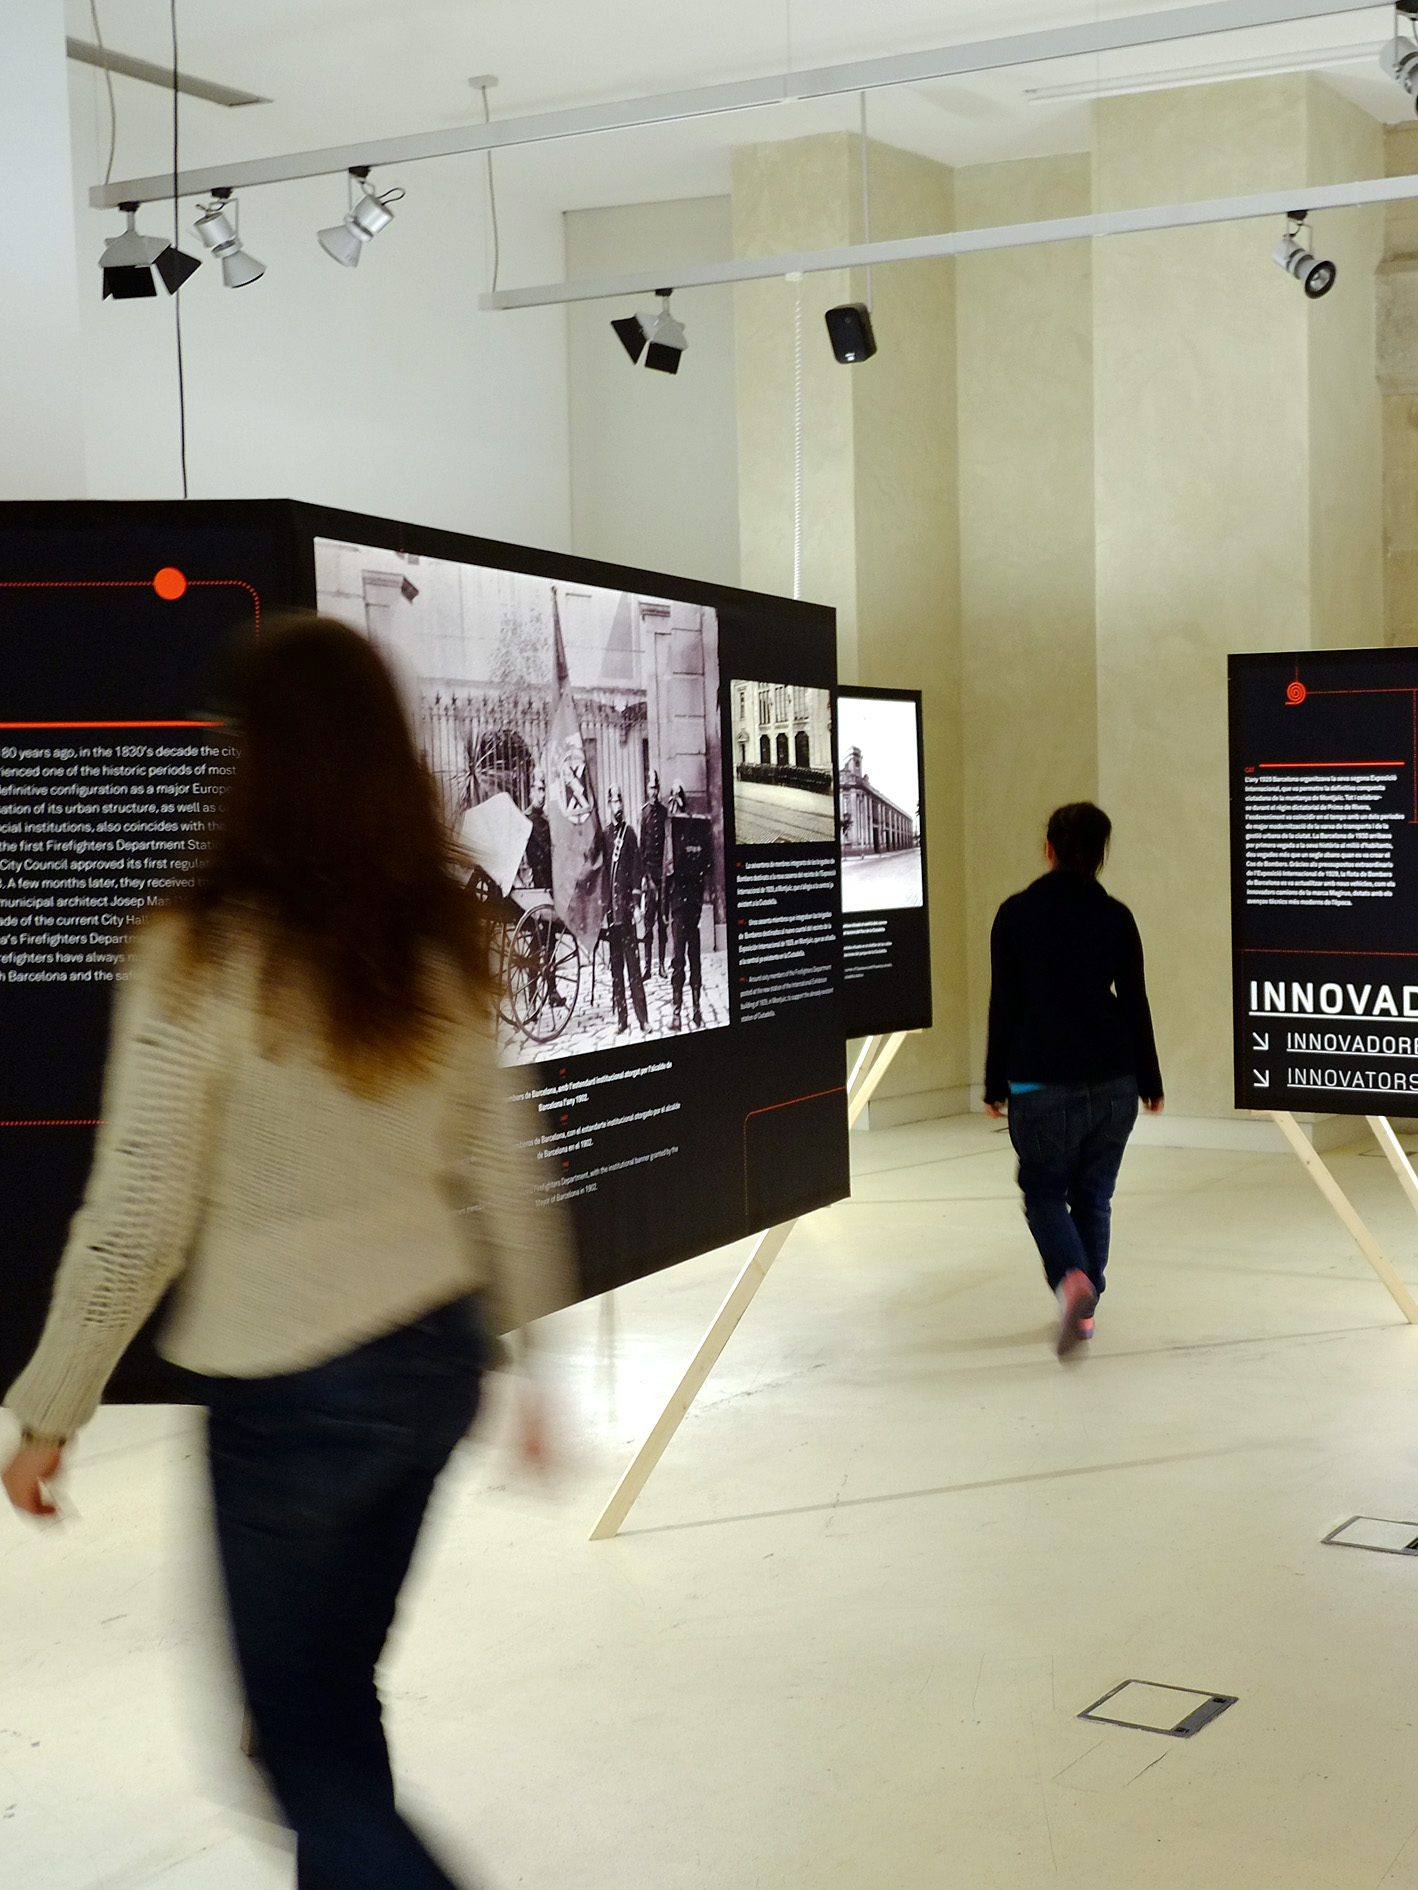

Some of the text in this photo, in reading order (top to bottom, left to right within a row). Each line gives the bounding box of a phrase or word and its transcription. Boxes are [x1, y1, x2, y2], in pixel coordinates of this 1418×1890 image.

[19, 748, 51, 761] years
[53, 748, 78, 761] ago,
[79, 746, 91, 758] in
[93, 746, 113, 758] the
[155, 745, 198, 757] decade
[201, 745, 219, 757] the
[222, 745, 242, 759] city
[42, 767, 64, 777] one
[66, 765, 79, 777] of
[80, 765, 100, 777] the
[102, 765, 147, 777] historic
[149, 764, 192, 778] periods
[194, 763, 207, 776] of
[209, 764, 237, 776] most
[50, 783, 128, 798] configuration
[130, 785, 145, 795] as
[146, 785, 154, 795] a
[156, 783, 190, 797] major
[33, 802, 45, 815] of
[47, 803, 62, 815] its
[65, 802, 100, 814] urban
[102, 803, 159, 814] structure,
[160, 803, 175, 813] as
[177, 802, 200, 813] well
[202, 804, 216, 813] as
[24, 822, 95, 834] institutions,
[96, 821, 121, 833] also
[123, 820, 179, 832] coincides
[181, 821, 205, 832] with
[19, 840, 44, 852] first
[46, 839, 114, 854] Firefighters
[116, 838, 185, 853] Department
[0, 858, 22, 873] City
[23, 858, 68, 871] Council
[70, 858, 124, 872] approved
[127, 858, 142, 870] its
[144, 857, 168, 869] first
[7, 877, 16, 889] A
[18, 877, 39, 890] few
[41, 877, 86, 889] months
[88, 877, 118, 889] later,
[120, 877, 146, 891] they
[147, 877, 195, 888] received
[0, 896, 54, 910] municipal
[57, 896, 109, 908] architect
[110, 895, 144, 908] Josep
[20, 914, 32, 927] of
[34, 914, 55, 926] the
[56, 915, 100, 926] current
[101, 913, 124, 928] City
[19, 932, 87, 948] Firefighters
[0, 952, 125, 967] efighters have always
[8, 970, 67, 983] Barcelona
[69, 969, 91, 982] and
[94, 970, 113, 981] the
